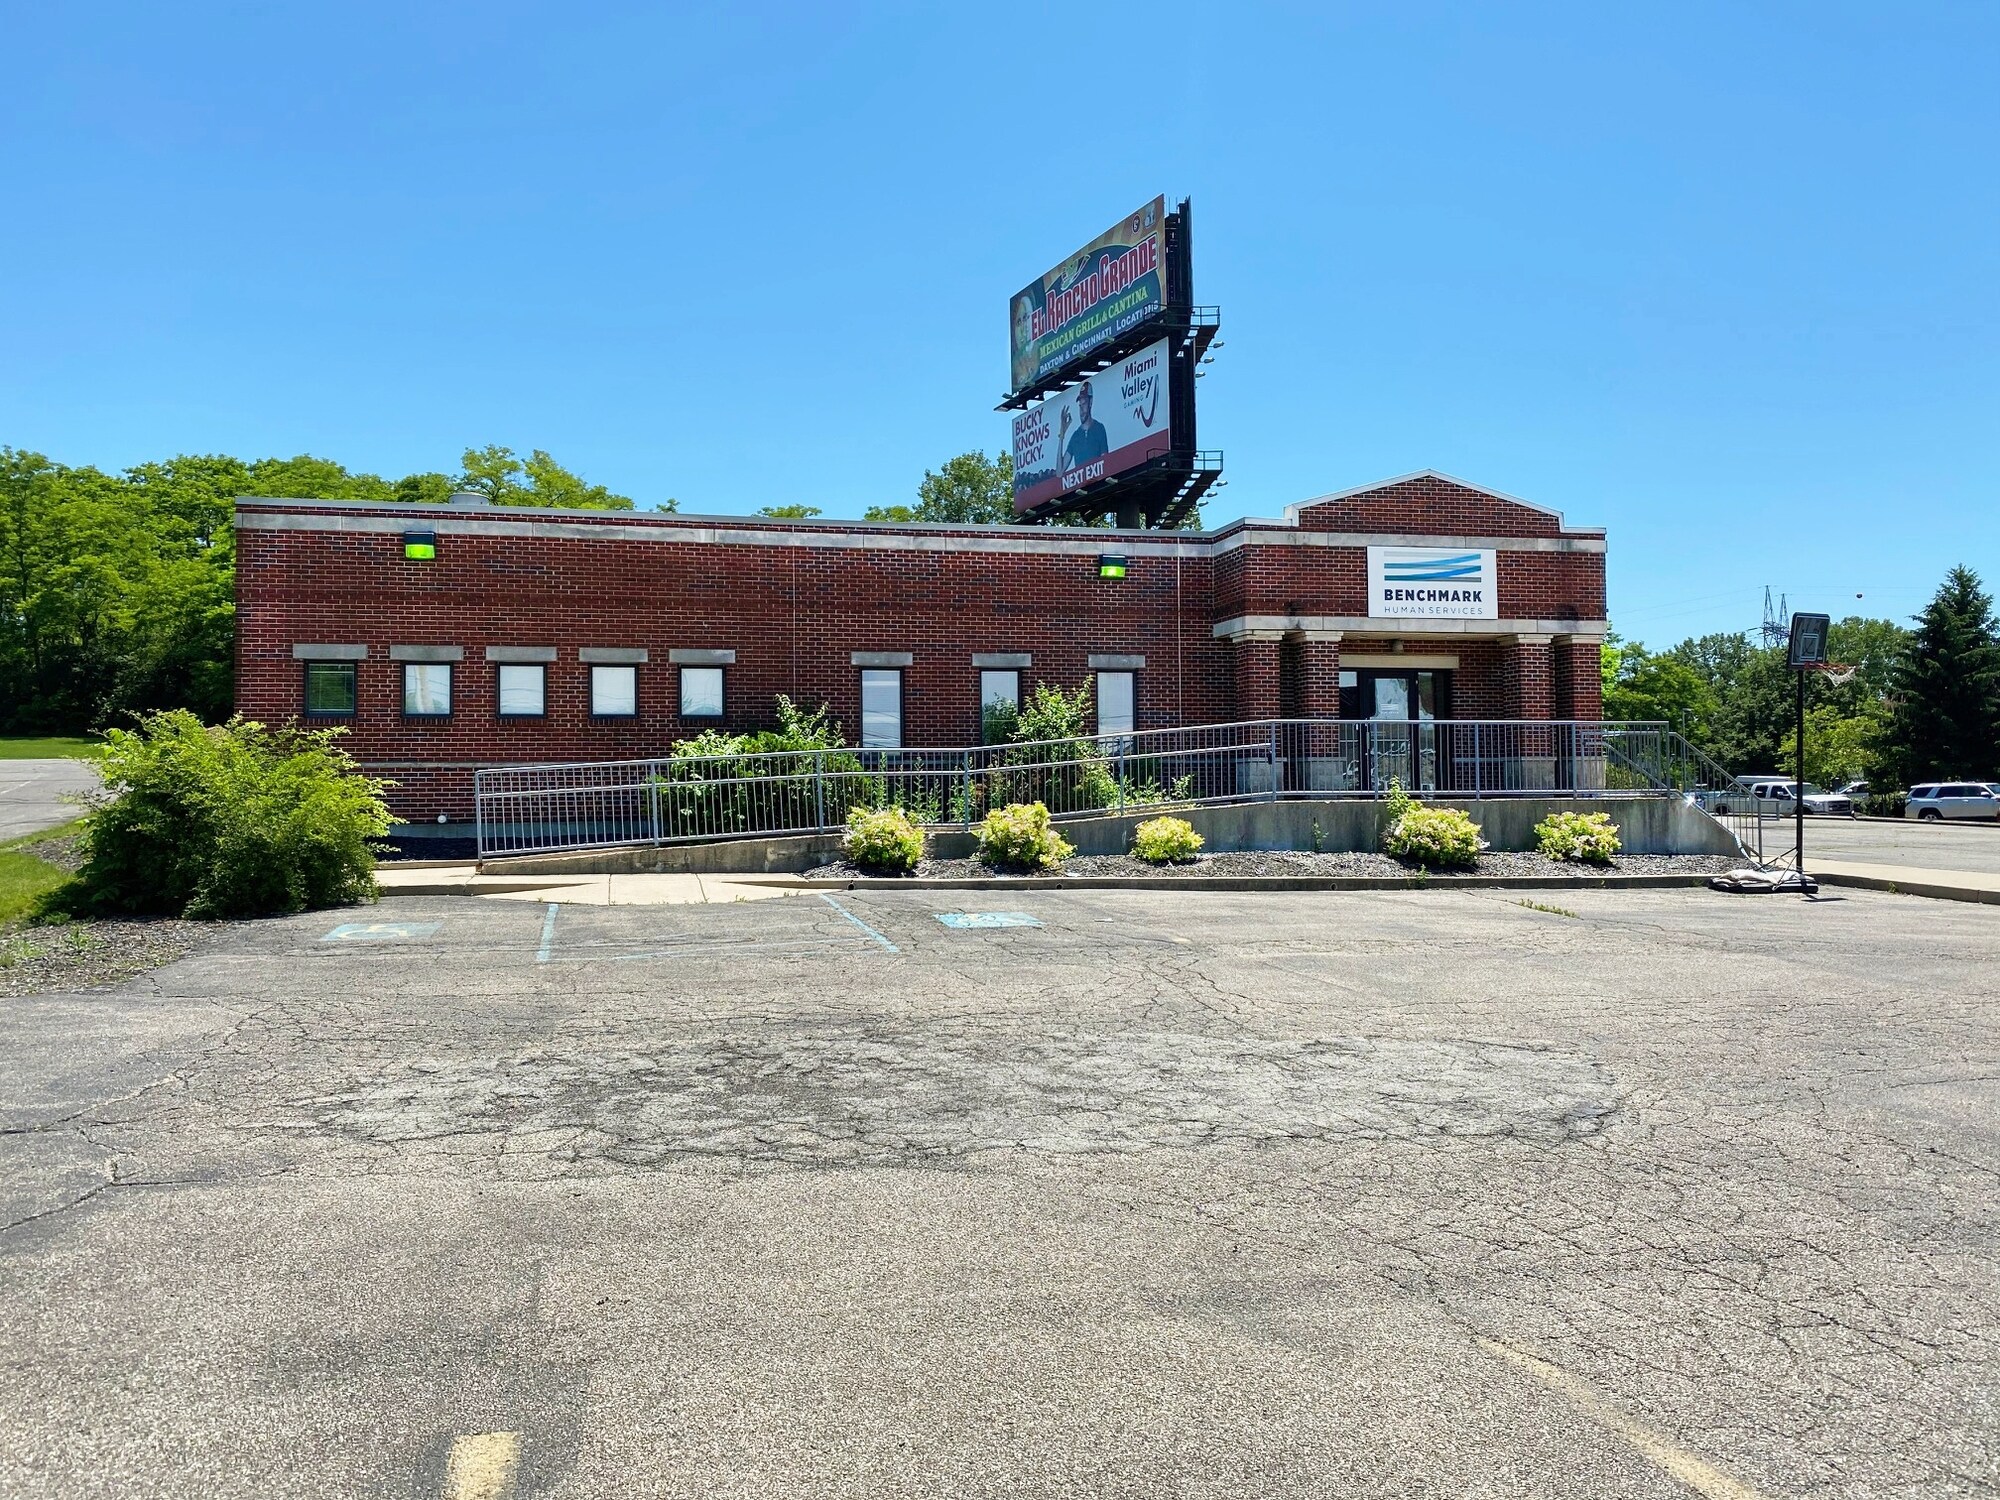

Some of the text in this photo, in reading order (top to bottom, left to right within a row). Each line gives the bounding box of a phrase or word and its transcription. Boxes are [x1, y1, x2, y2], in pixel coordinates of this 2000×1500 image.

[1031, 232, 1158, 342] EL RANCHO GRANDE
[1040, 286, 1149, 359] MEXICAN GRILL & CANTINA
[1040, 353, 1064, 375] DAYTON
[1124, 351, 1158, 382] Miami
[1121, 375, 1154, 400] Valley
[1015, 408, 1045, 436] BUCKY
[1016, 423, 1050, 453] KNOWS
[1016, 444, 1045, 471] LUCKY.
[1062, 460, 1105, 491] NEXT EXIT
[1384, 588, 1482, 602] BENCHMARK
[1384, 606, 1483, 615] HUMAN SERVICES
